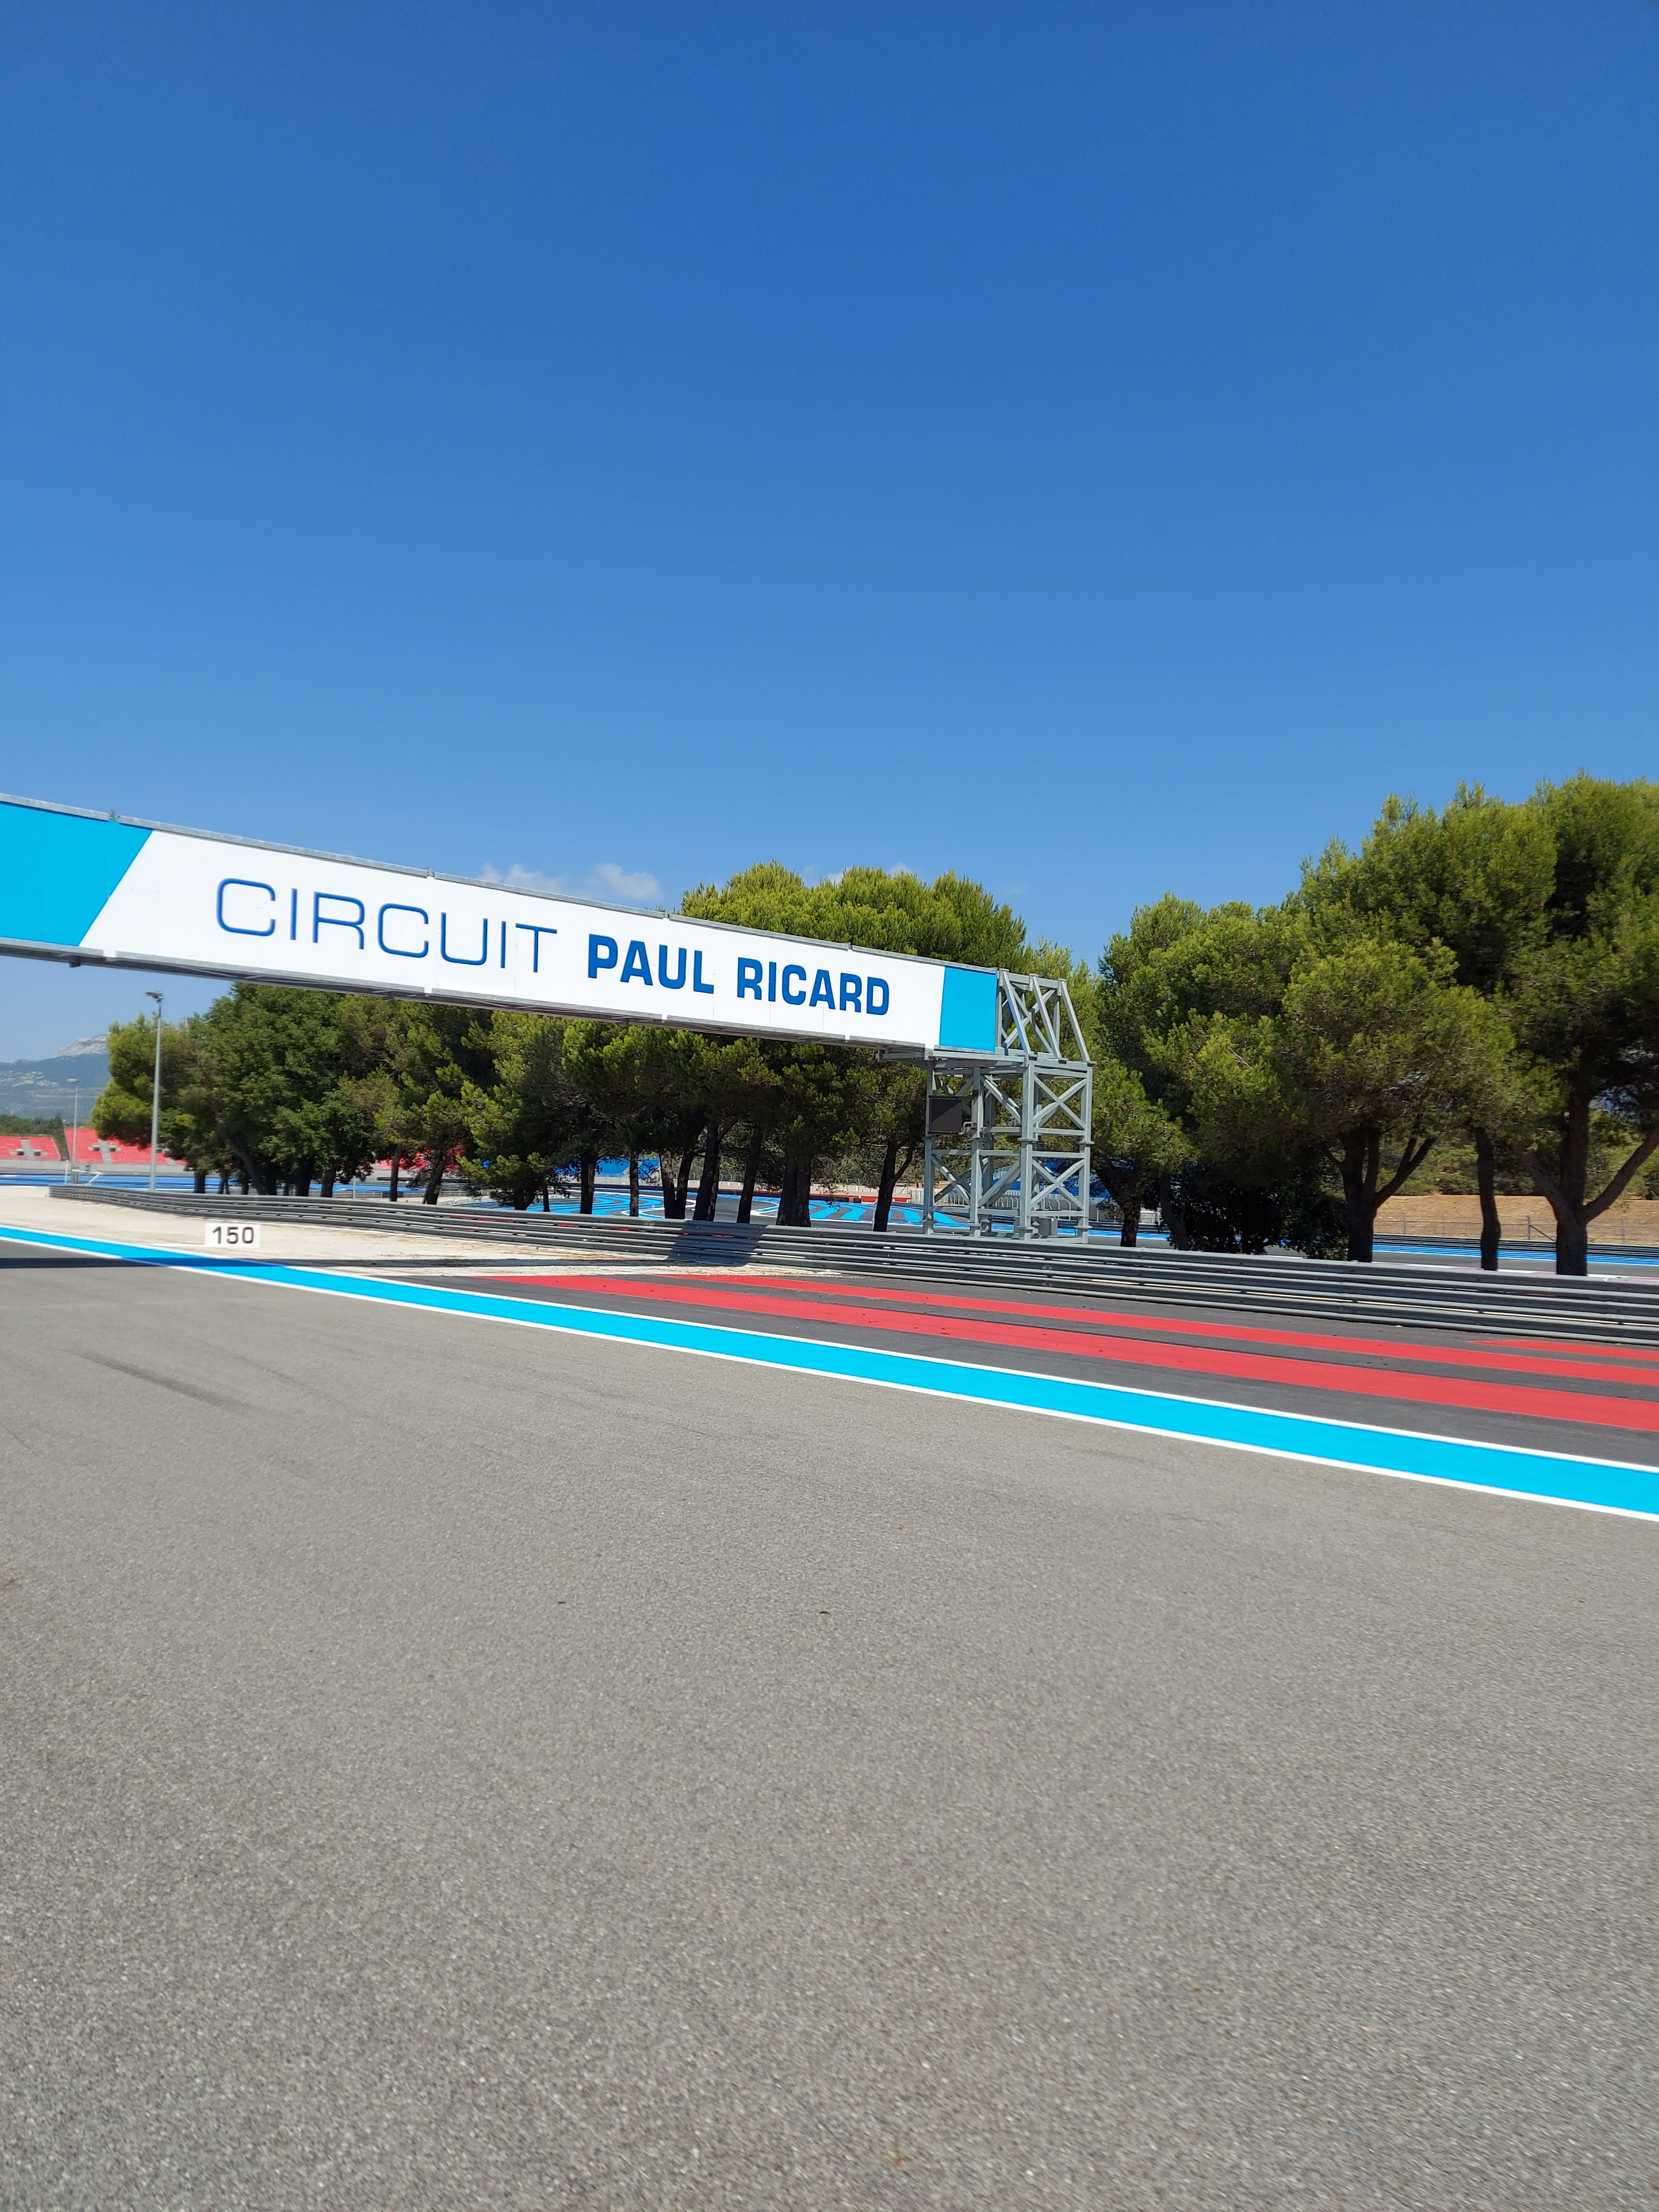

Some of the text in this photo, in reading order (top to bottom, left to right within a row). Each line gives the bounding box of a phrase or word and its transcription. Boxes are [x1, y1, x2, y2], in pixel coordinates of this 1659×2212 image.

[216, 877, 890, 1016] CIRCUIT PAUL RICARD
[212, 1226, 254, 1244] 150
